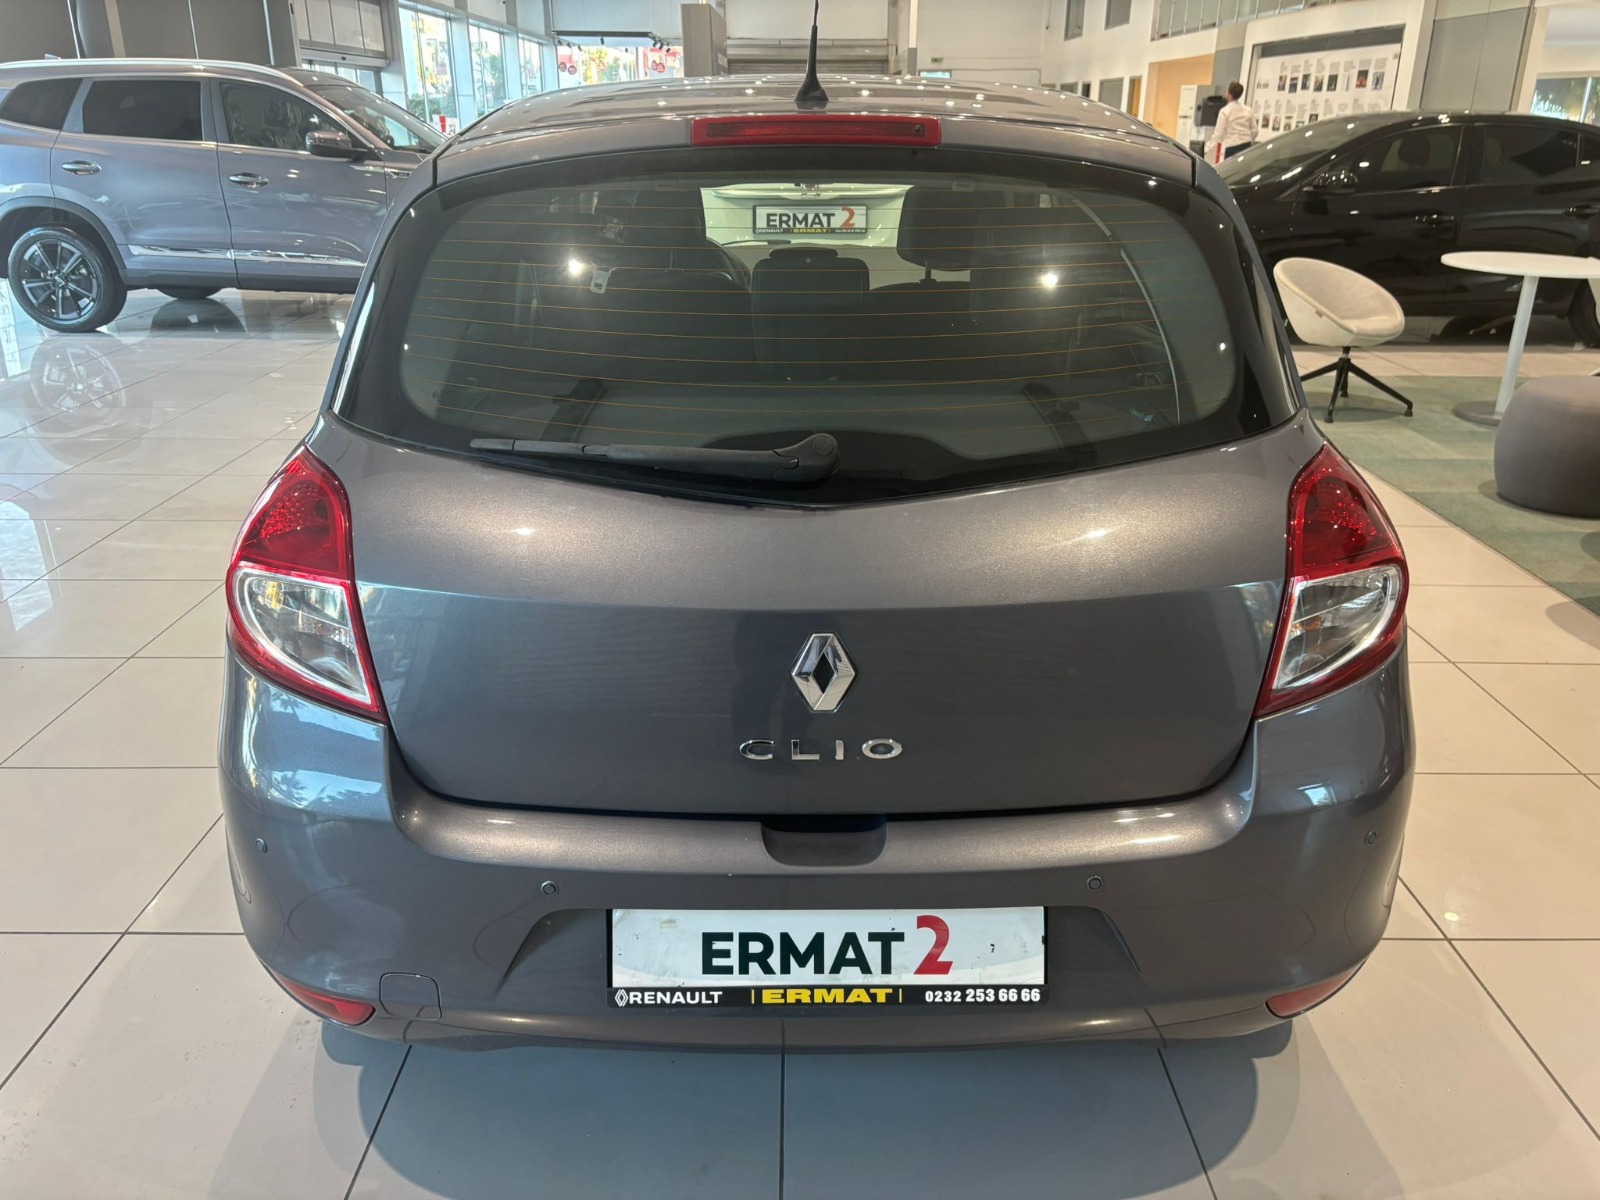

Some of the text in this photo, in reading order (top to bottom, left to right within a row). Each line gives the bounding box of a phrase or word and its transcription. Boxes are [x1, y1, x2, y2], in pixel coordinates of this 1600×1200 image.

[766, 207, 855, 228] ERMAT 2
[739, 738, 904, 761] CLIO
[702, 914, 954, 975] ERMAT 2
[629, 988, 1041, 1005] RENAULT ERMAT 0232 253 66 66
